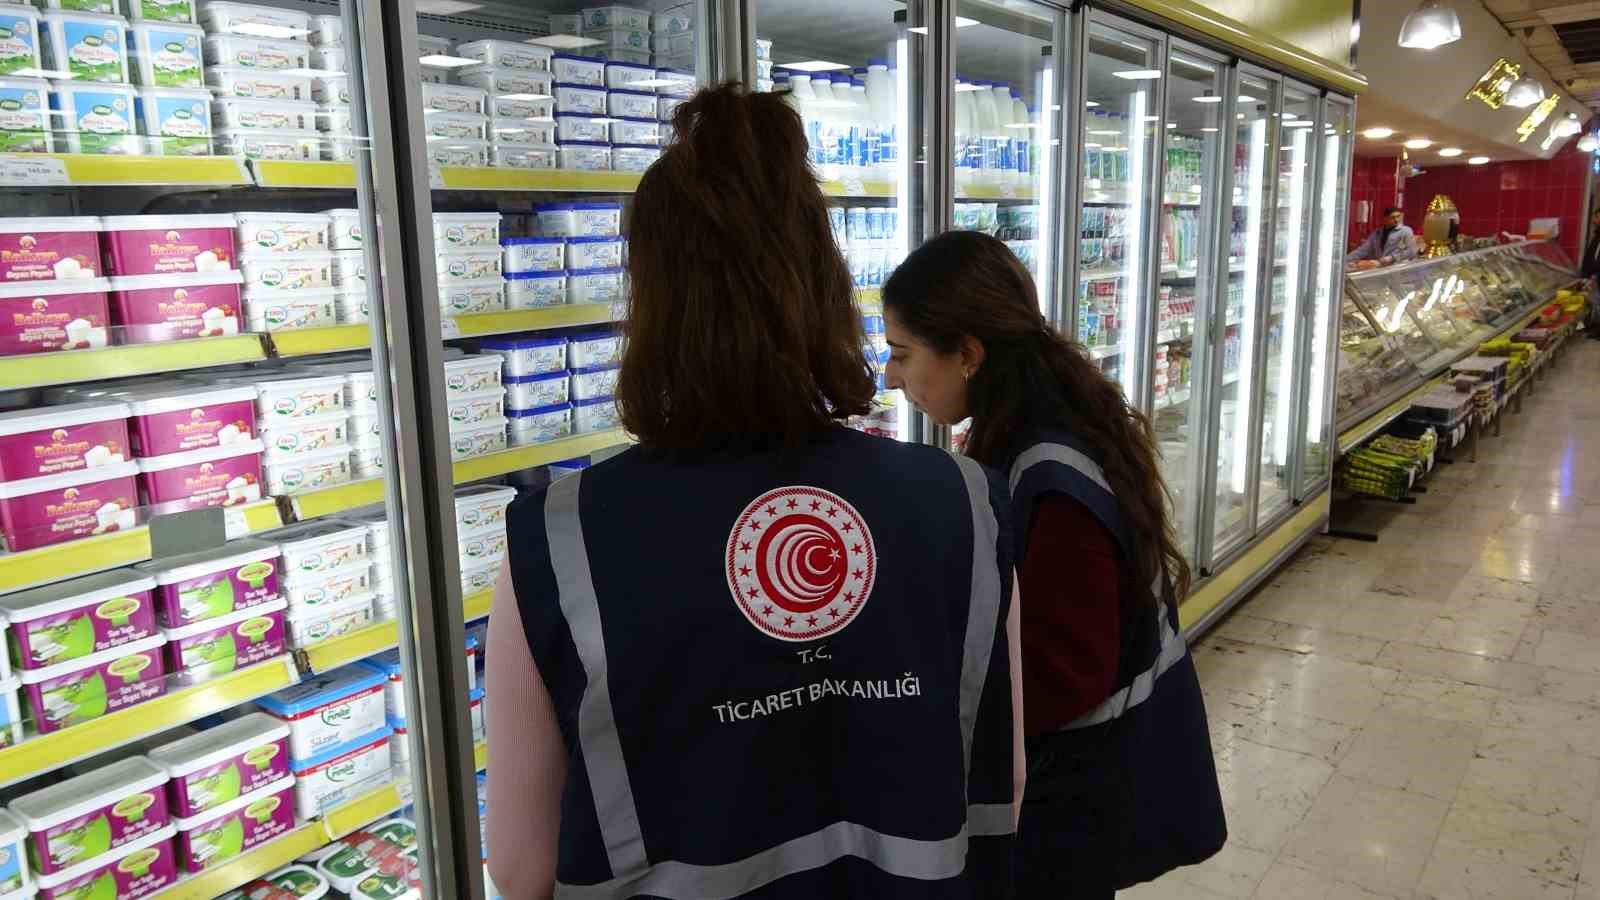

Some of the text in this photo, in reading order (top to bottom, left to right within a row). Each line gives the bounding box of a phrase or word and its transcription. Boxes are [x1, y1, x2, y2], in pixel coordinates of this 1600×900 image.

[797, 646, 832, 664] T.C.
[712, 672, 921, 723] TİCARET BAKANLIĞI
